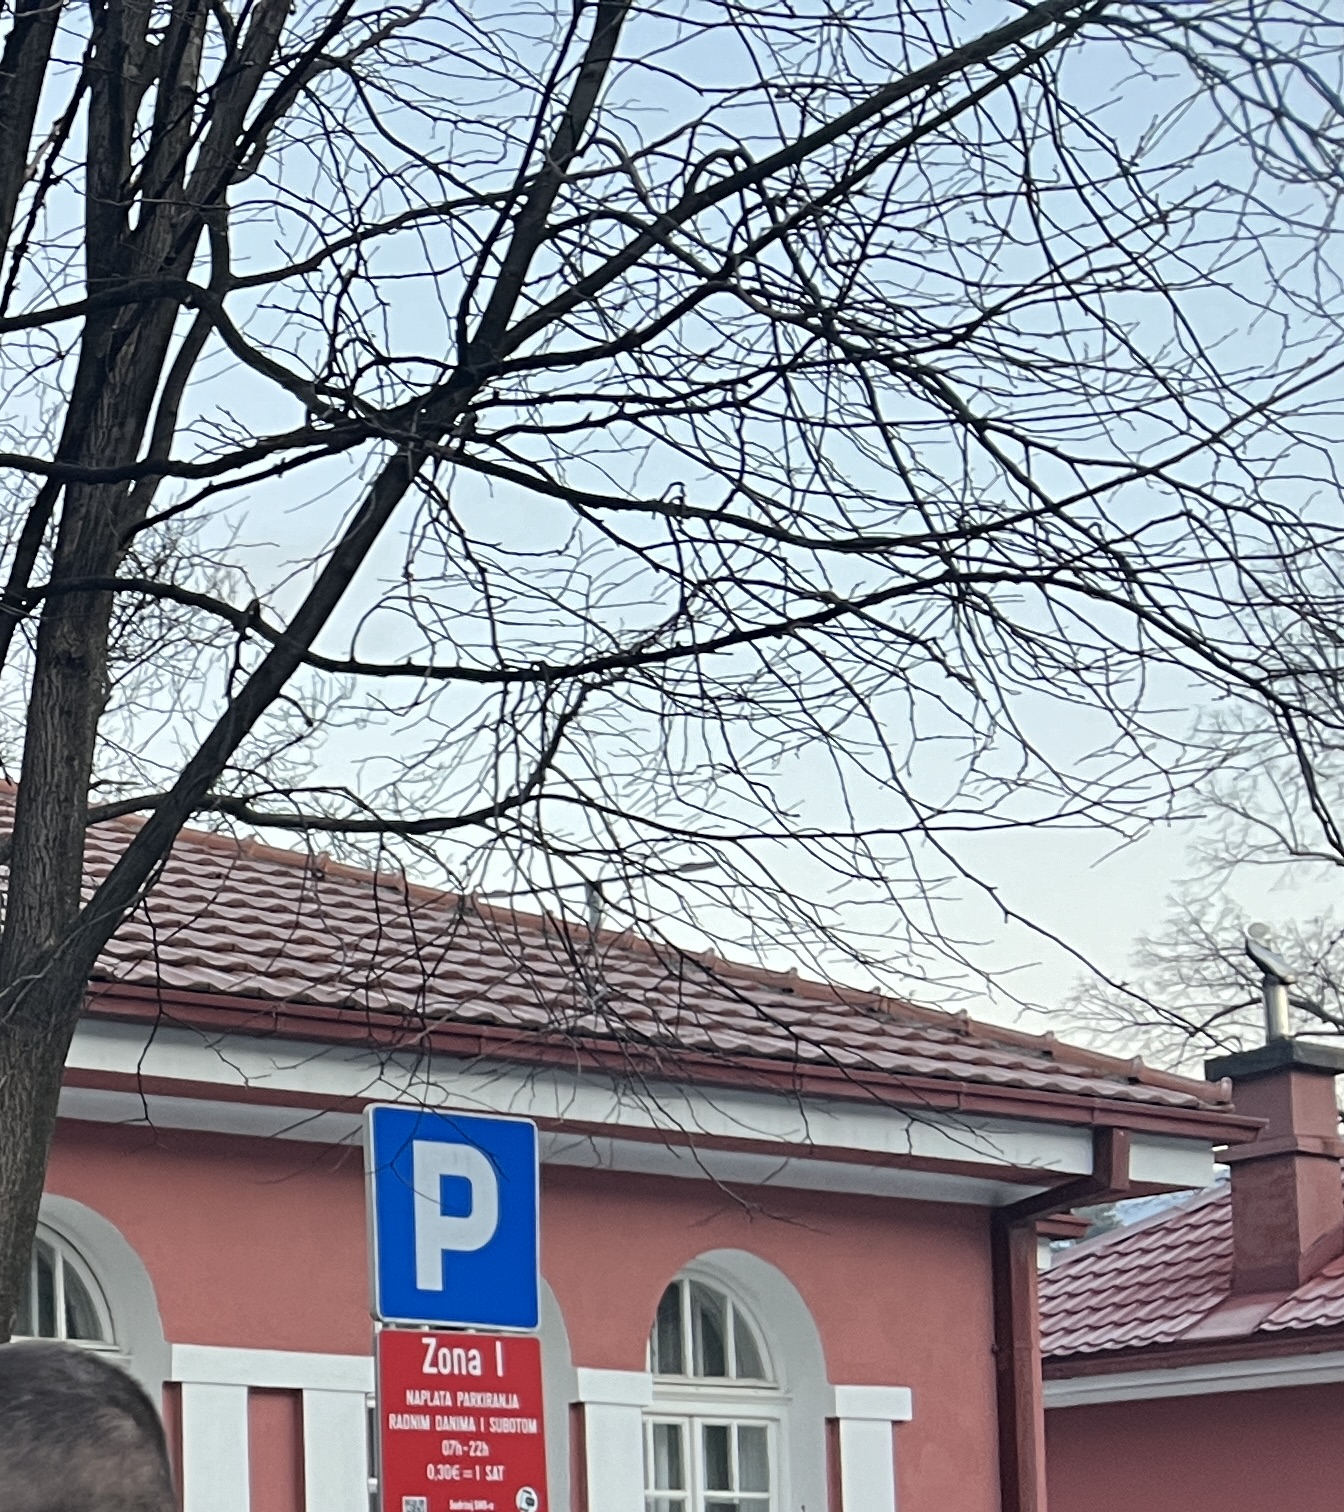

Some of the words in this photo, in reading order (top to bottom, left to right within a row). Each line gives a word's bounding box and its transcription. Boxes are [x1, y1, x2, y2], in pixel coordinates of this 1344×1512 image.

[413, 1139, 499, 1291] P
[422, 1337, 481, 1376] Zona
[406, 1389, 452, 1407] NAPLATA
[457, 1391, 520, 1409] PARKIRANJA
[388, 1413, 430, 1430] RADNIM
[435, 1415, 476, 1432] DANIMA
[489, 1417, 538, 1434] SUBOTOM
[485, 1465, 504, 1481] SAT
